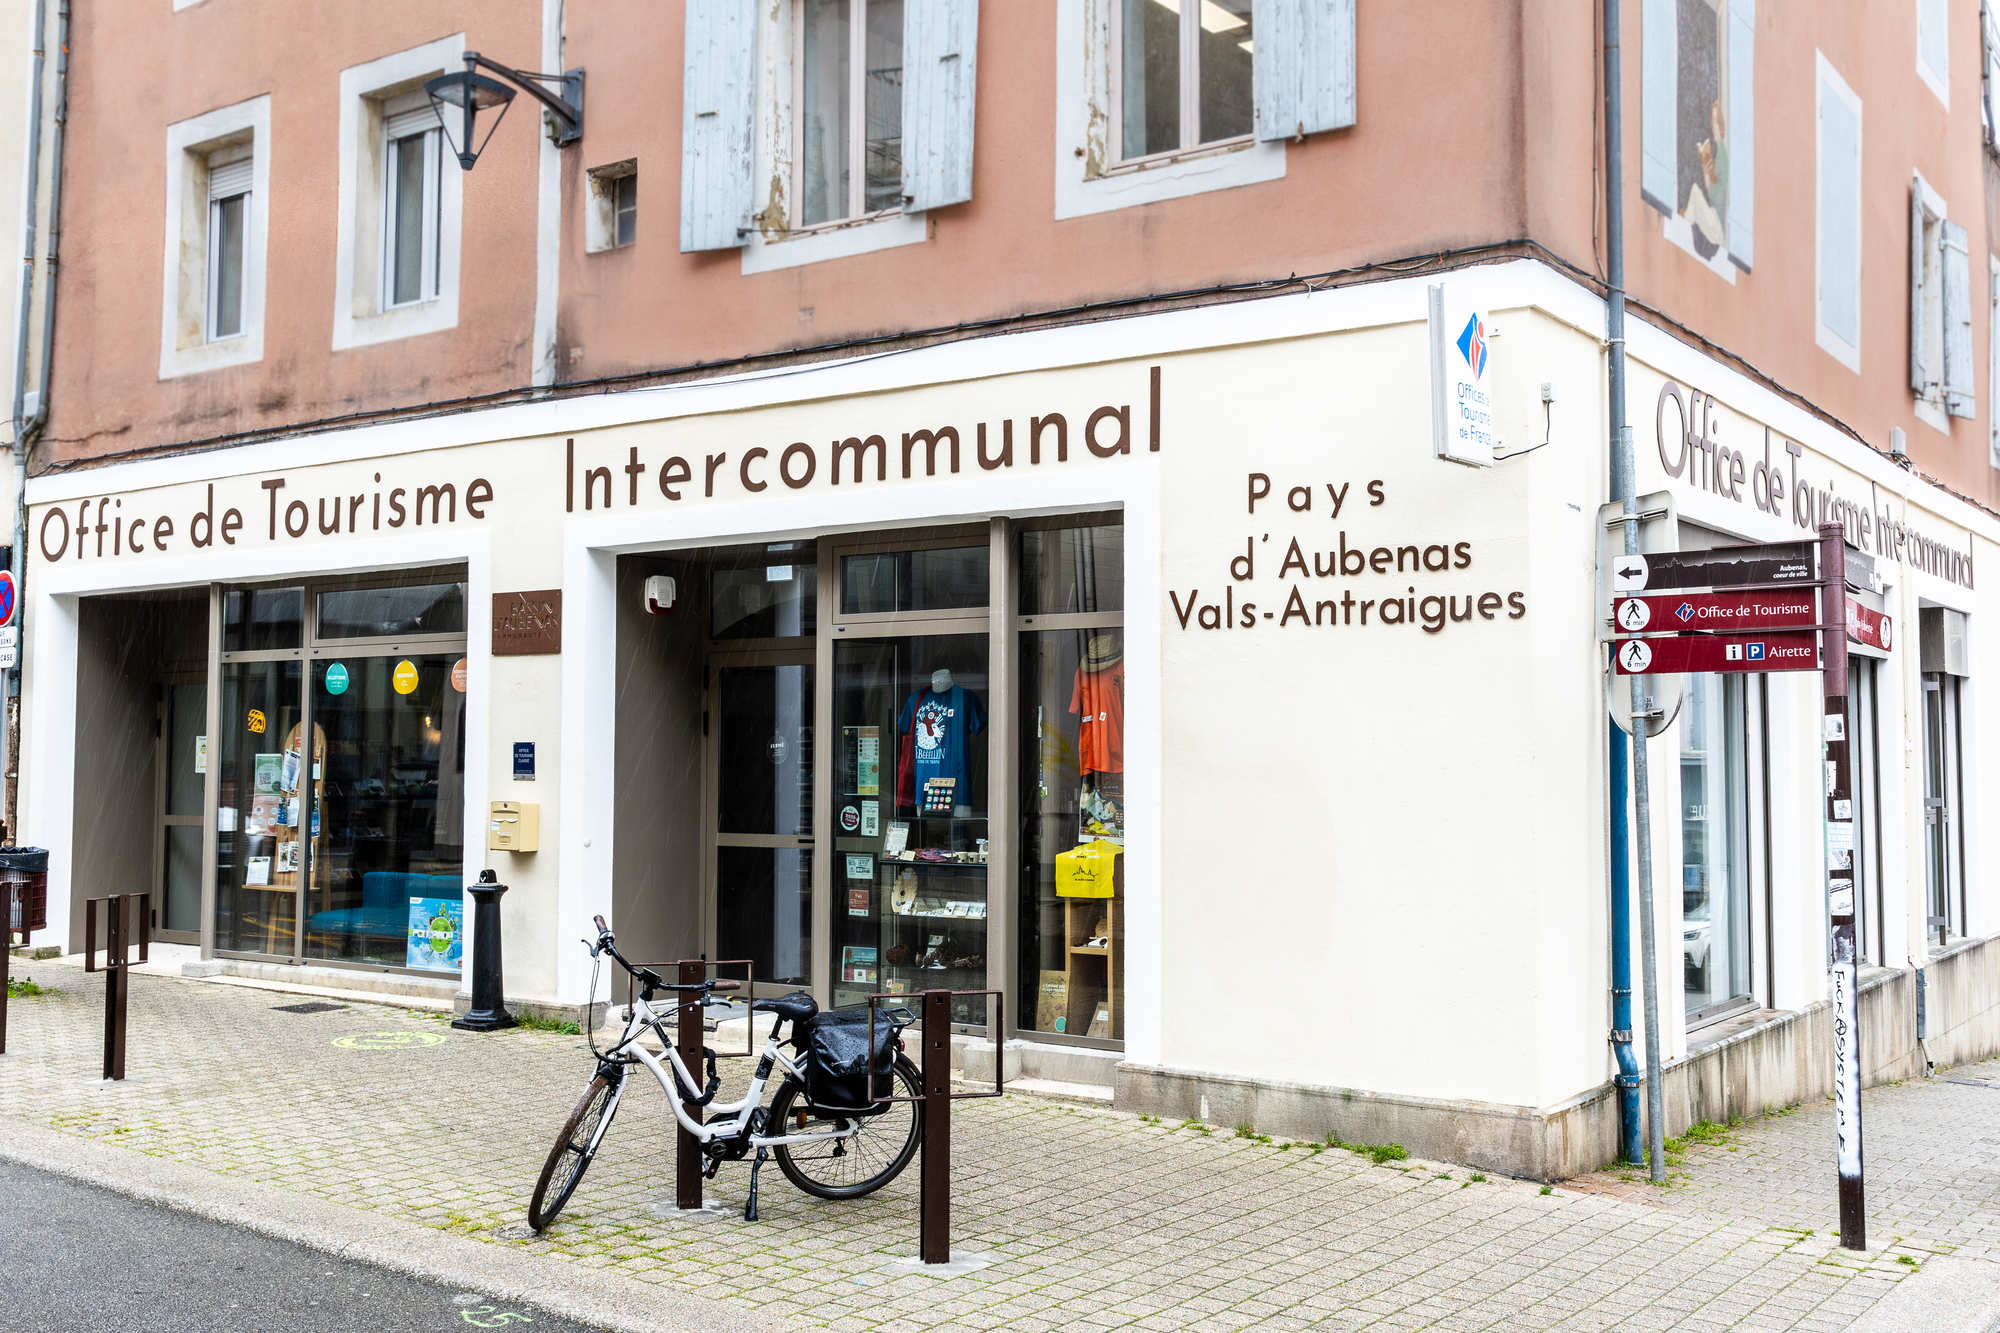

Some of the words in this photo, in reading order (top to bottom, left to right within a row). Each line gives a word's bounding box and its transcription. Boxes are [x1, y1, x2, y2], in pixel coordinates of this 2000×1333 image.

[1457, 381, 1484, 404] Offices
[565, 366, 1161, 513] Intercommunal
[1248, 472, 1386, 519] Pays
[1656, 380, 1746, 503] Office
[1753, 426, 1785, 518] de
[1786, 440, 1872, 552] Tourisme
[1872, 480, 1974, 591] Intecommunal
[40, 497, 174, 563] Office
[190, 483, 243, 548] de
[261, 472, 494, 541] Tourisme
[1169, 584, 1526, 635] Vals-Antraigues
[1697, 605, 1732, 619] Office
[1735, 605, 1750, 616] de
[1754, 602, 1809, 617] Tourisme
[1768, 645, 1811, 658] Airette
